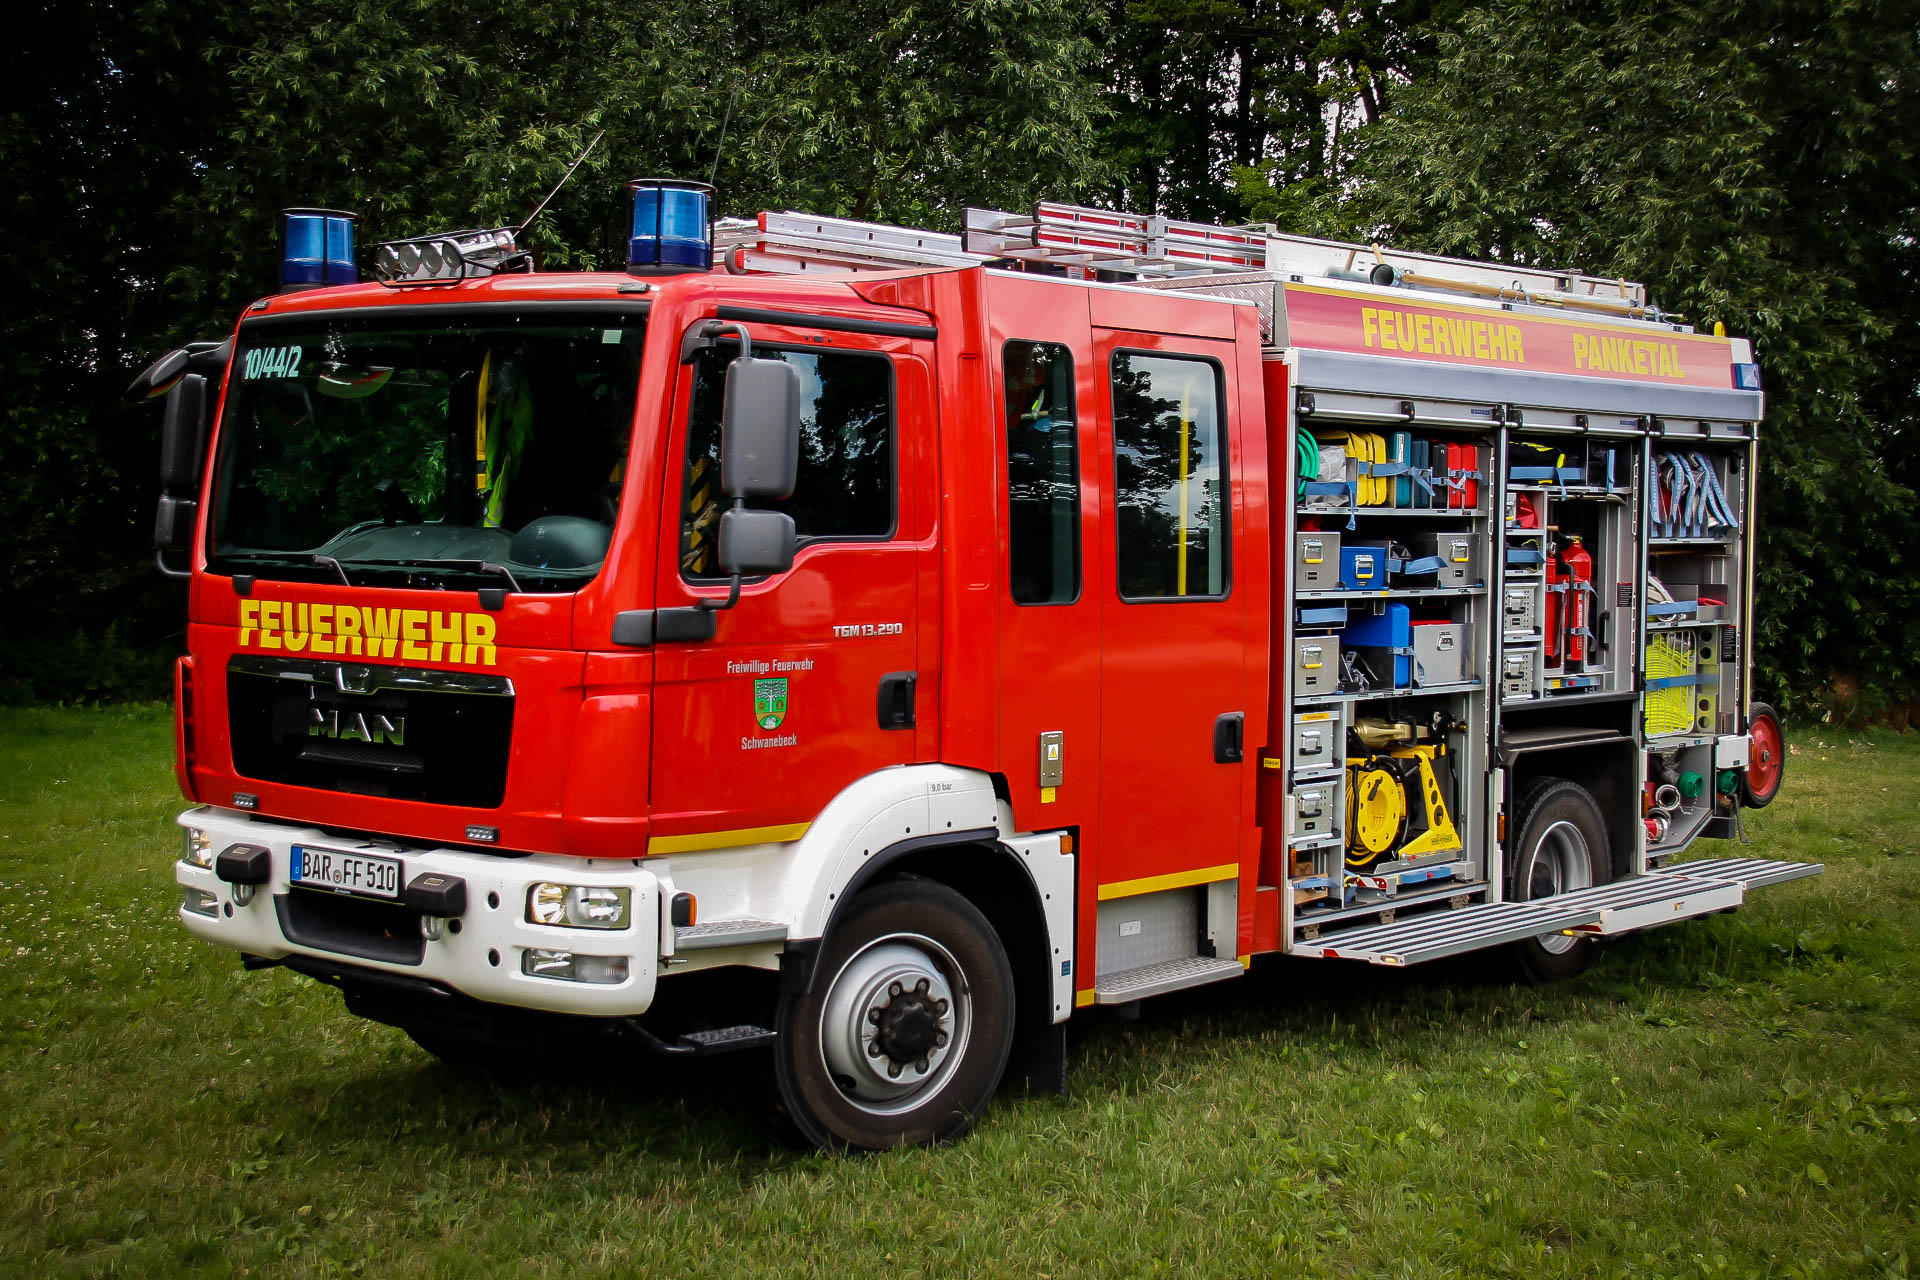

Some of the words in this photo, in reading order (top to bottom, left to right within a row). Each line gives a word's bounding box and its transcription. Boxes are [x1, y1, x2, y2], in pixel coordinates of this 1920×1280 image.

[1361, 307, 1525, 362] FEUERWEHR
[1572, 333, 1685, 378] PANKETAL
[245, 345, 302, 380] 10/44/2
[239, 599, 497, 666] FEUERWEHR
[832, 625, 860, 638] TGM
[861, 622, 903, 637] 13.290
[727, 660, 770, 675] Freiwillige
[772, 658, 814, 672] Feuerwehr
[308, 708, 405, 746] MAN
[741, 733, 798, 750] Schwanebeck
[302, 852, 332, 881] BAR
[343, 858, 363, 885] FF
[366, 862, 396, 891] 510
